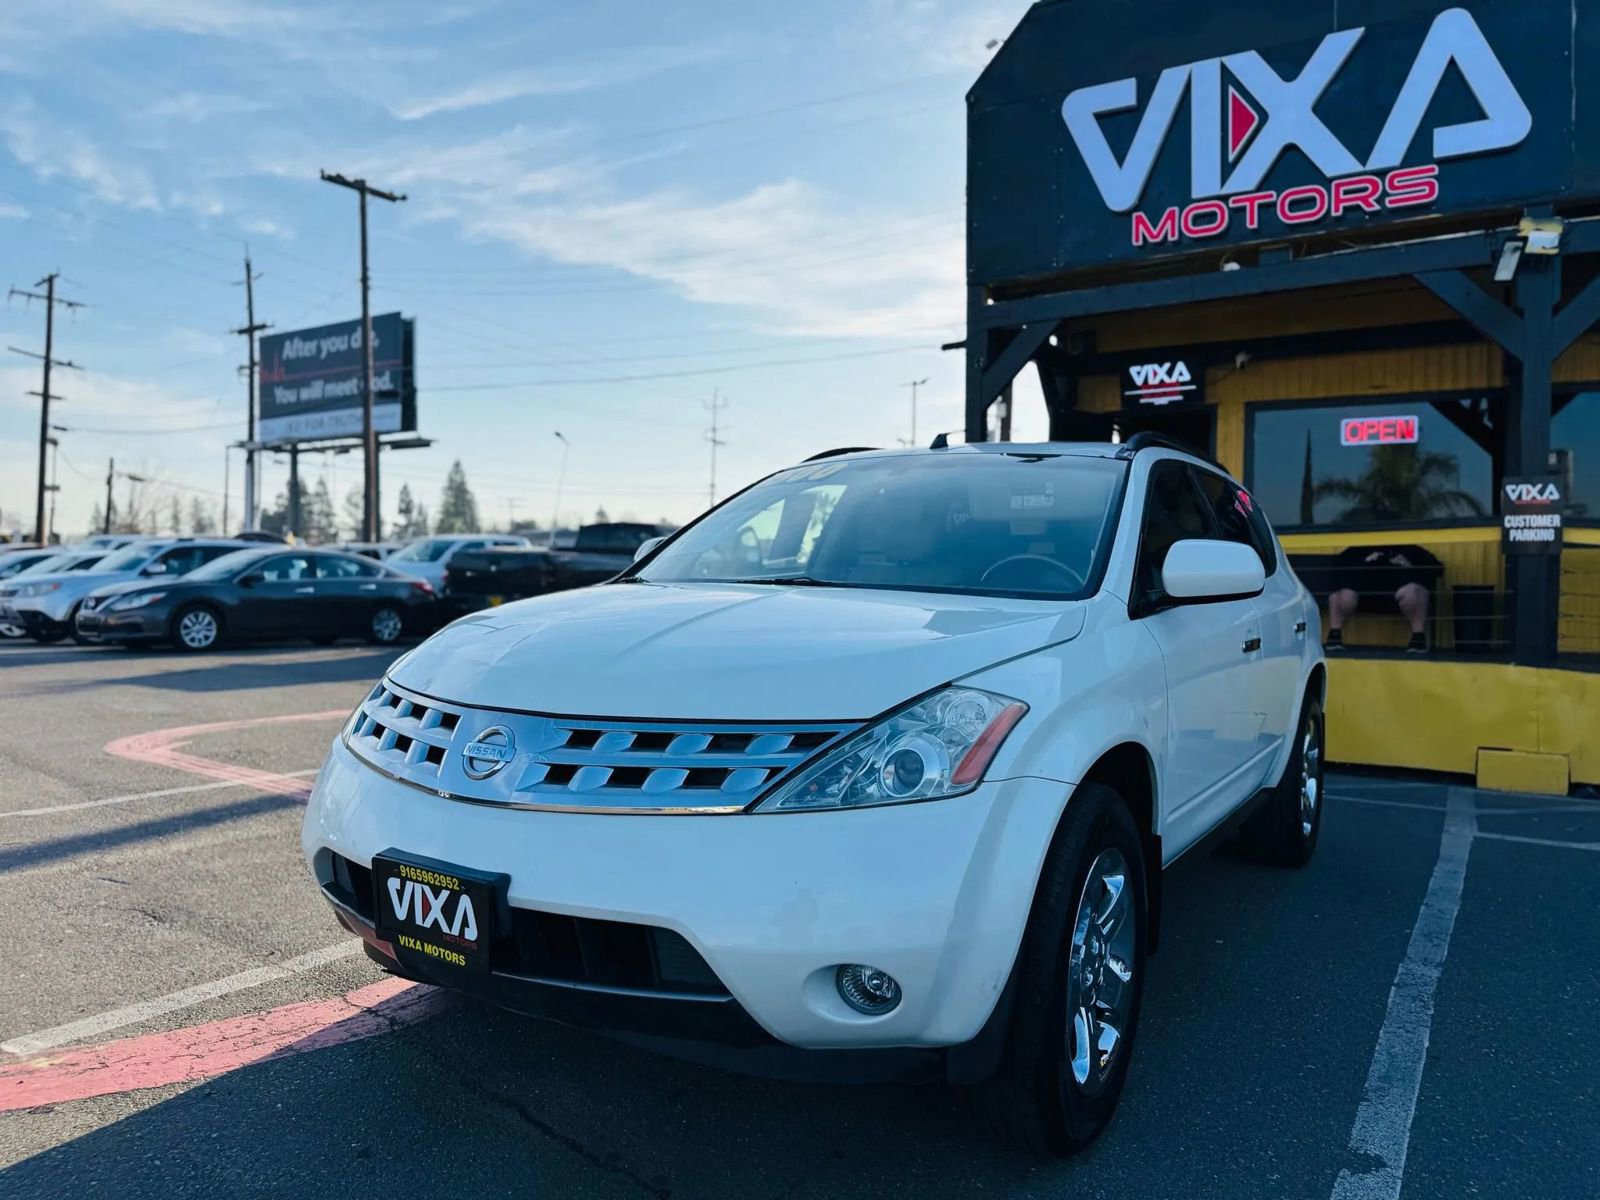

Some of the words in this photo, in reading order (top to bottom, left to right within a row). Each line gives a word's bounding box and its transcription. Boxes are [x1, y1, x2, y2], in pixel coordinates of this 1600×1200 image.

[1062, 7, 1532, 212] VIXA
[1131, 164, 1440, 247] MOTORS
[282, 336, 318, 360] After
[320, 333, 348, 360] you
[1129, 361, 1191, 386] VIXA
[274, 386, 297, 404] You
[324, 377, 358, 398] meet
[360, 370, 394, 393] od.
[1345, 418, 1415, 443] OPEN
[1505, 483, 1560, 501] VIXA
[1504, 514, 1561, 528] CUSTOMER
[1509, 528, 1555, 542] PARKING
[467, 745, 507, 758] NISSAN
[400, 865, 460, 890] 9165962952
[387, 877, 478, 941] VIXA
[398, 935, 422, 951] VIXA
[424, 943, 466, 966] MOTORS
